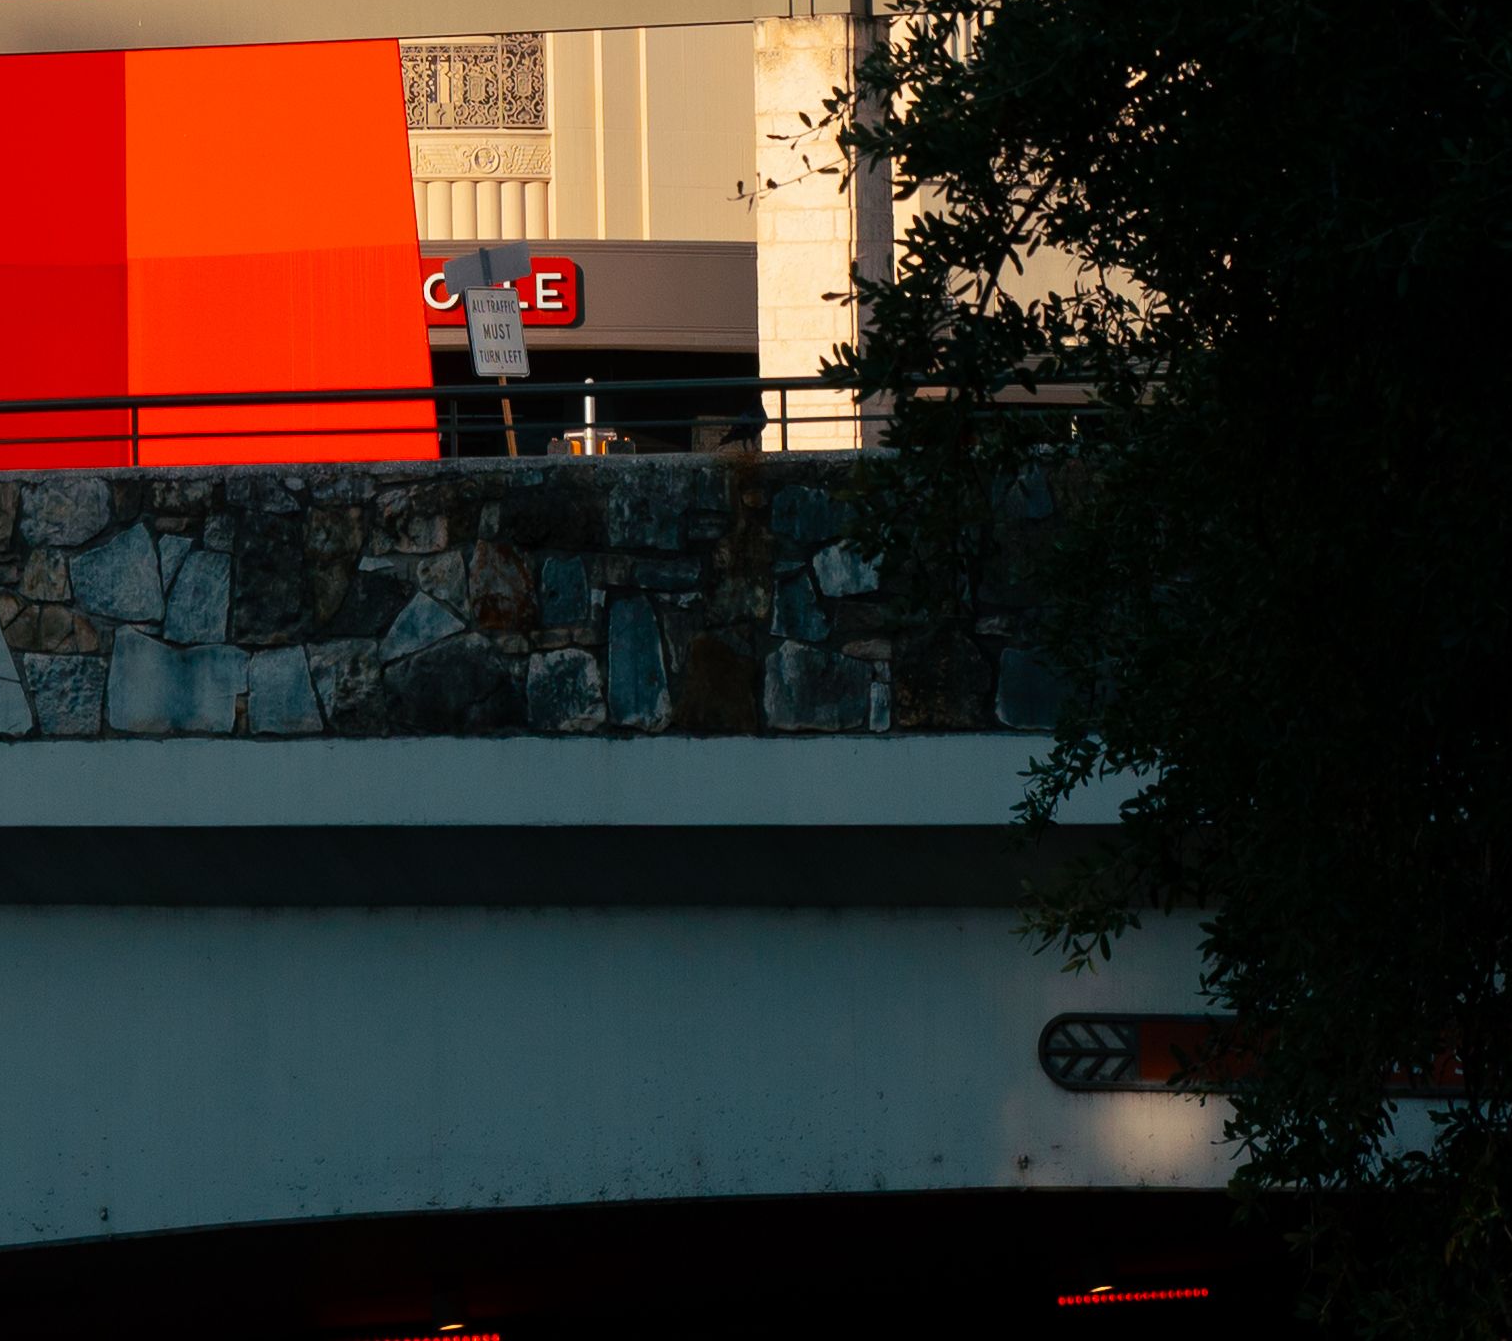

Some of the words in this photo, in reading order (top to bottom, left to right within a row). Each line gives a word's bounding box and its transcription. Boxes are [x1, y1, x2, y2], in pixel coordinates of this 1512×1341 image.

[472, 299, 485, 314] ALL
[486, 299, 517, 315] TRAFFIC
[483, 324, 511, 340] MUST
[479, 350, 501, 365] TURN
[504, 350, 522, 365] LEFT
